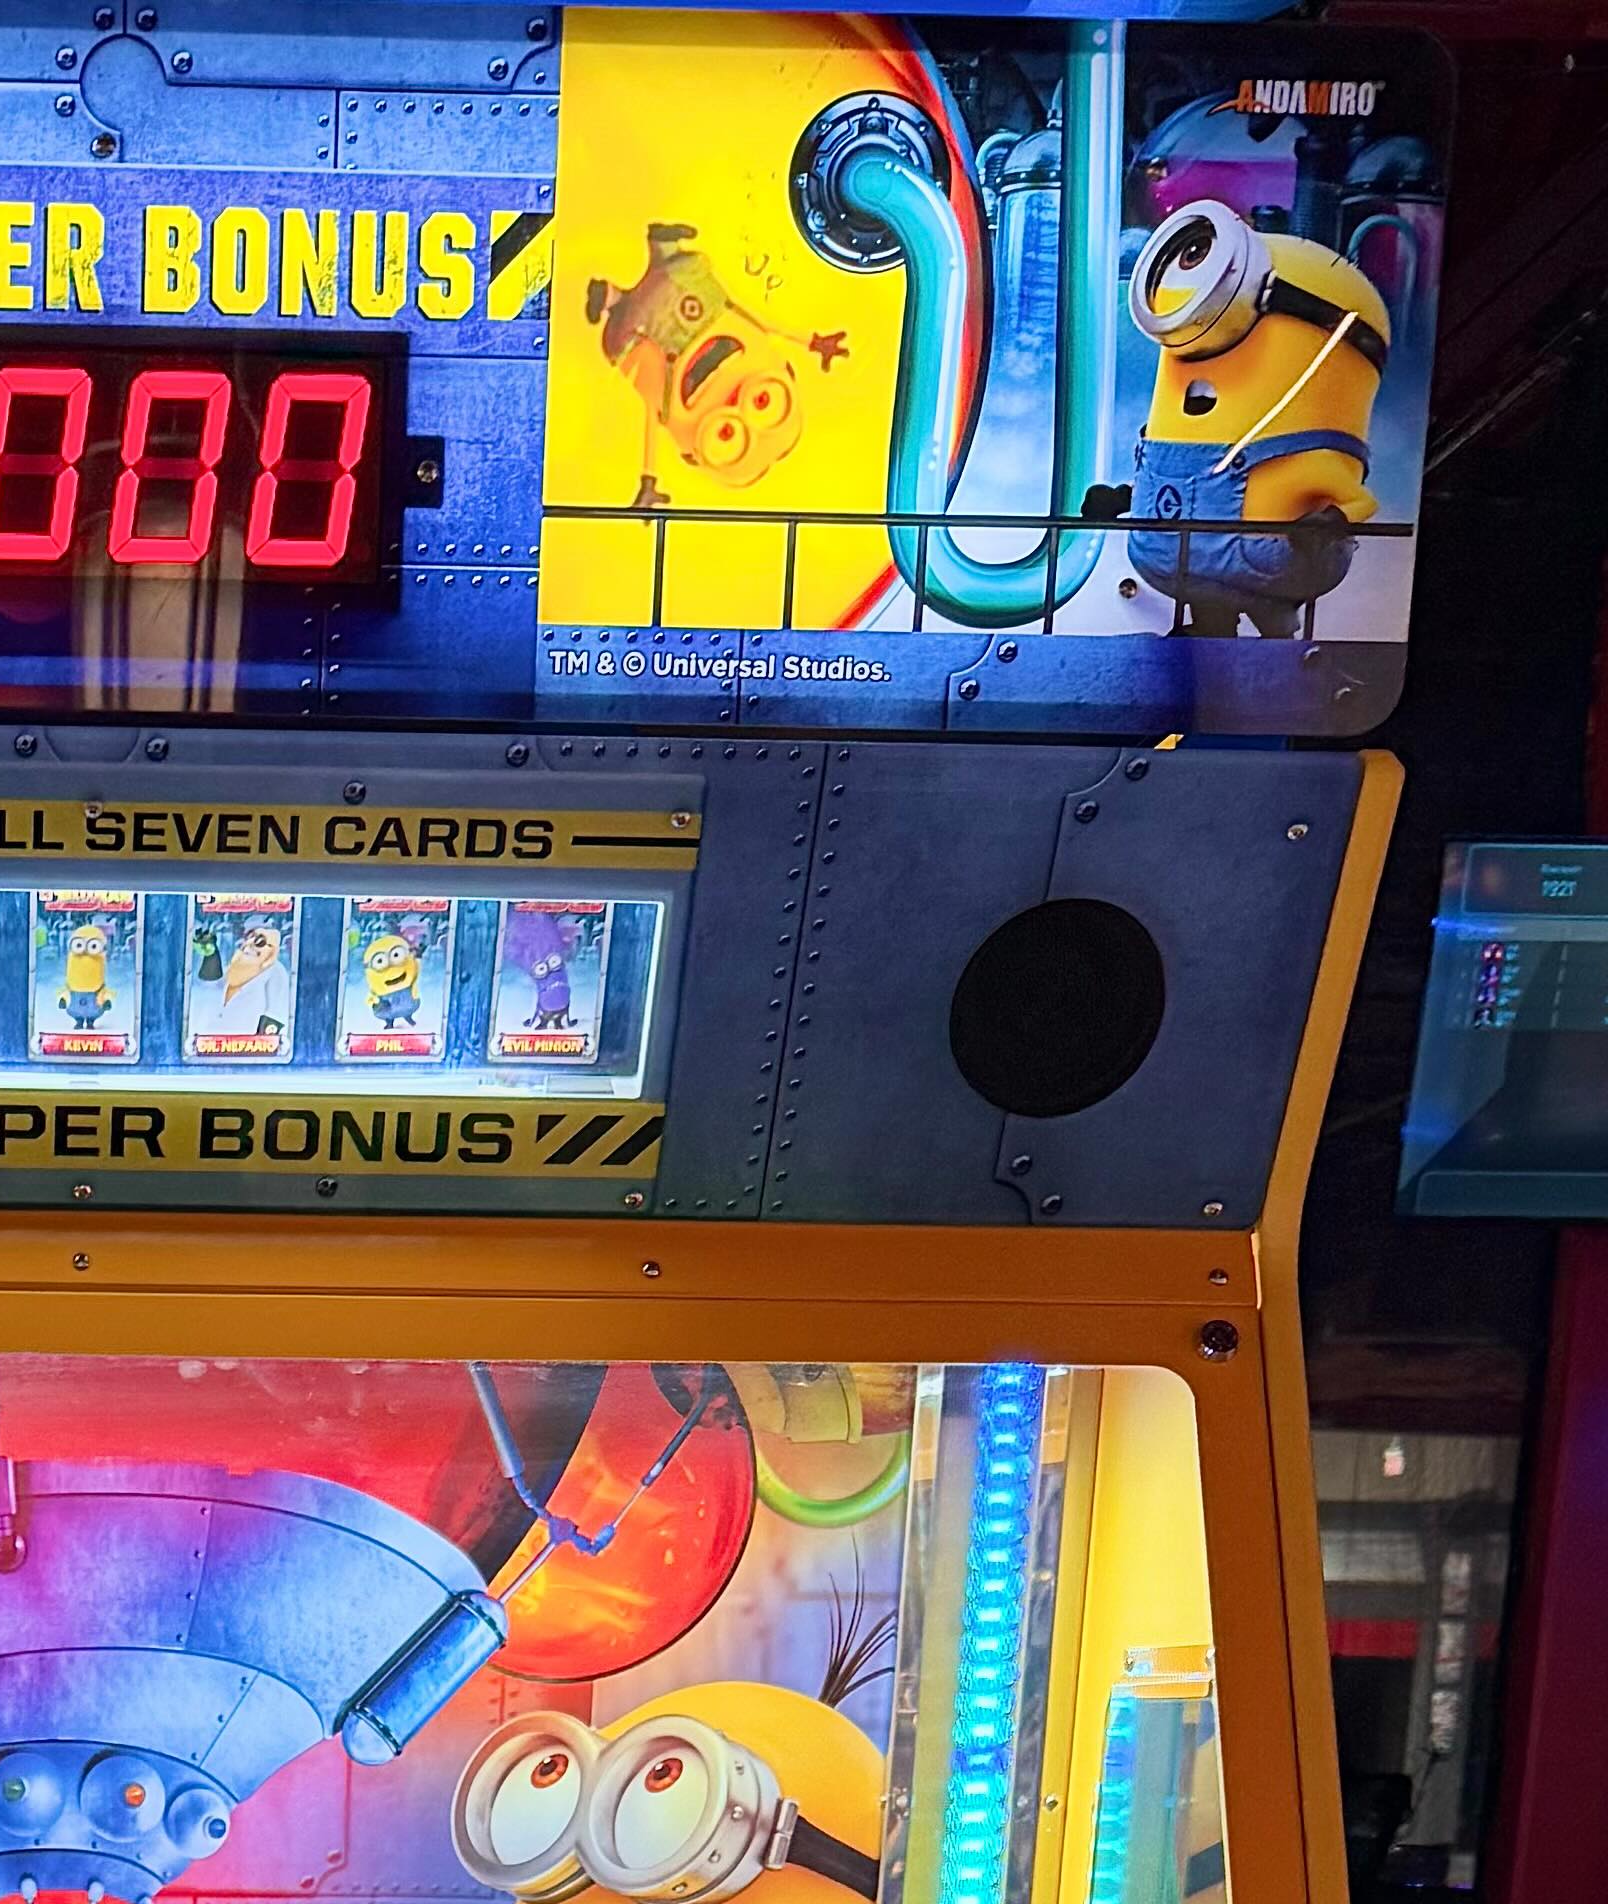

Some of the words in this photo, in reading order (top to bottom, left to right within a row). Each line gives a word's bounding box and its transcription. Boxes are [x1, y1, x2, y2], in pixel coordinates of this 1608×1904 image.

[1235, 79, 1377, 117] ANDAMIRO
[143, 203, 476, 320] BONUS
[549, 650, 589, 674] TM
[596, 652, 616, 675] &
[654, 652, 776, 679] Universal
[783, 656, 892, 681] Studios.
[84, 811, 301, 855] SEVEN
[323, 815, 555, 859] CARDS
[63, 1040, 104, 1052] KEVIN
[375, 1040, 405, 1052] PHIL
[199, 1108, 515, 1164] BONUS
